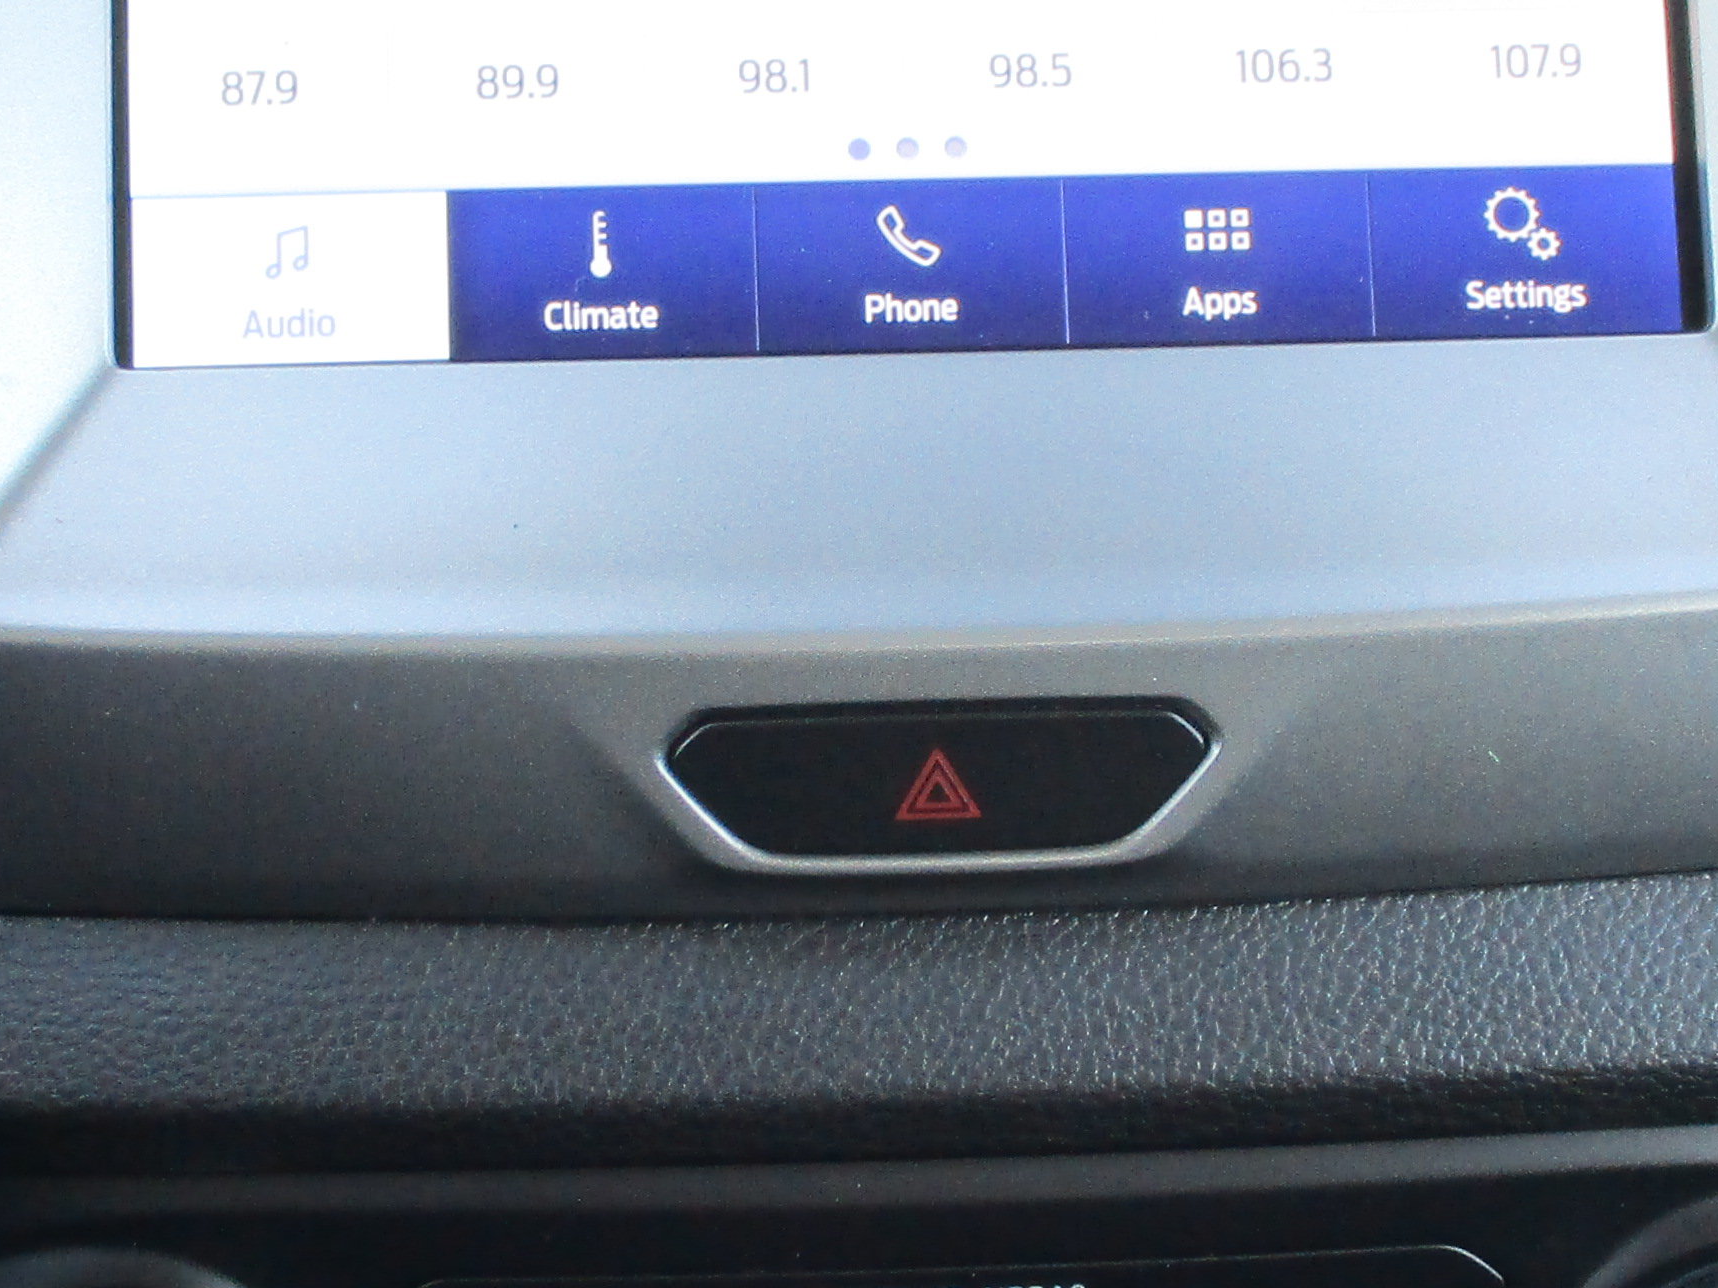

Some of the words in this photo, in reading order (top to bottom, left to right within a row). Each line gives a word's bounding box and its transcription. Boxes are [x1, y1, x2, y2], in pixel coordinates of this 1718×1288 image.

[738, 58, 810, 94] 98.1
[989, 52, 1072, 88] 98.5
[1236, 47, 1333, 83] 106.3
[1490, 42, 1582, 79] 107.9
[221, 69, 298, 106] 87.9
[476, 63, 559, 100] 89.9
[864, 292, 959, 324] Phone
[1182, 286, 1260, 321] Apps
[1465, 279, 1587, 313] Settings
[242, 308, 336, 339] Audio
[543, 300, 659, 332] Climate
